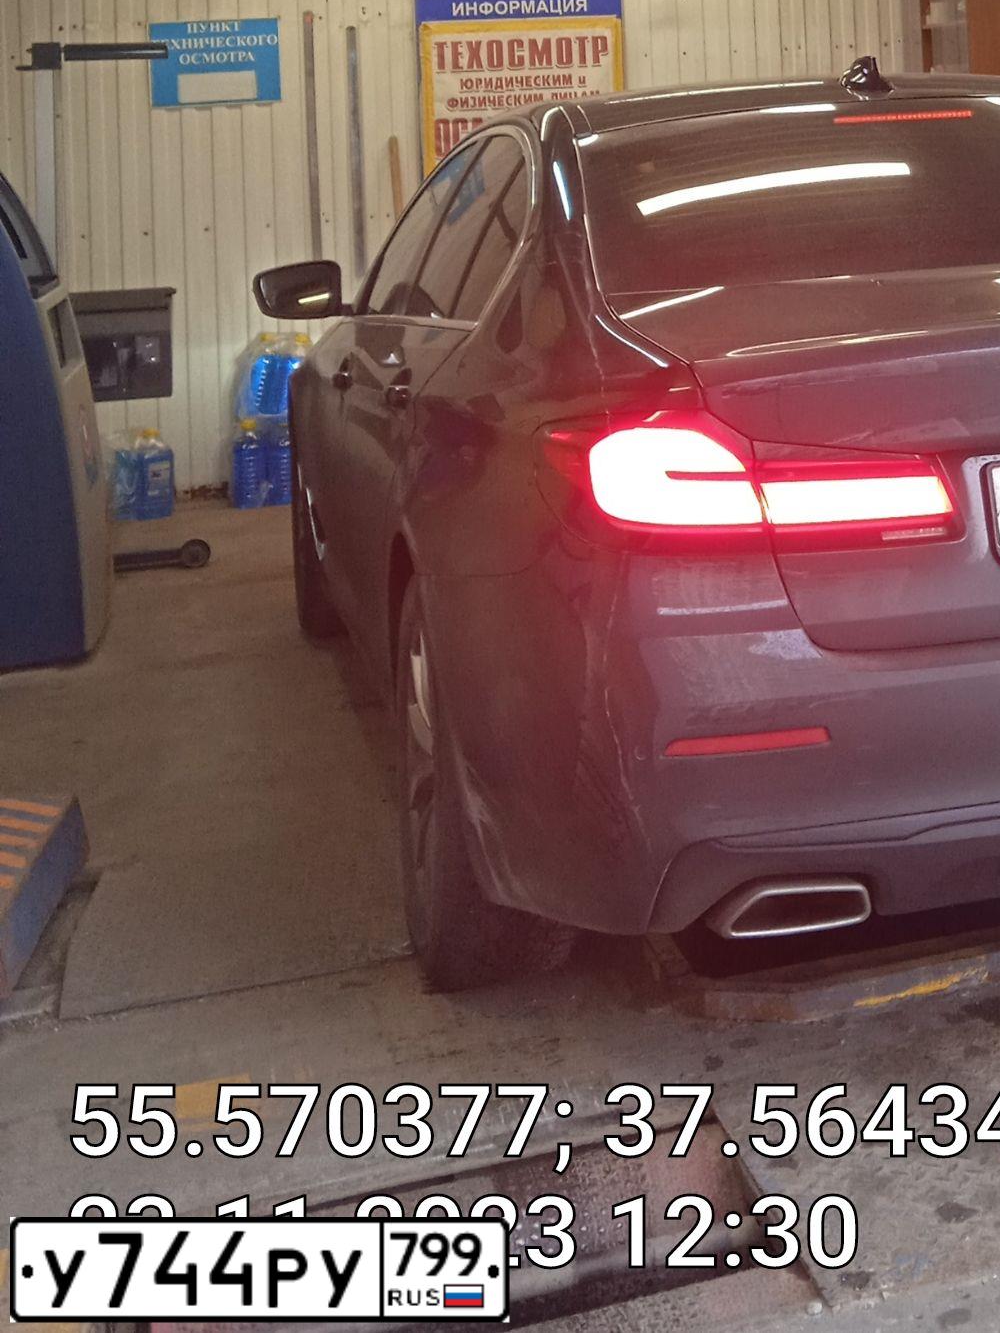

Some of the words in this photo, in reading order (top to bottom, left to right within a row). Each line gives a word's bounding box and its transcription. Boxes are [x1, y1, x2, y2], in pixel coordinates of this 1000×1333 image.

[187, 21, 241, 34] ПУНКТ
[179, 51, 255, 65] ОСМОТРА
[435, 35, 609, 72] ТЕХОСМОТР
[460, 74, 573, 91] ЮРИДИЧЕСКИМ
[446, 94, 544, 110] ФИЗИЧЕСКИМ
